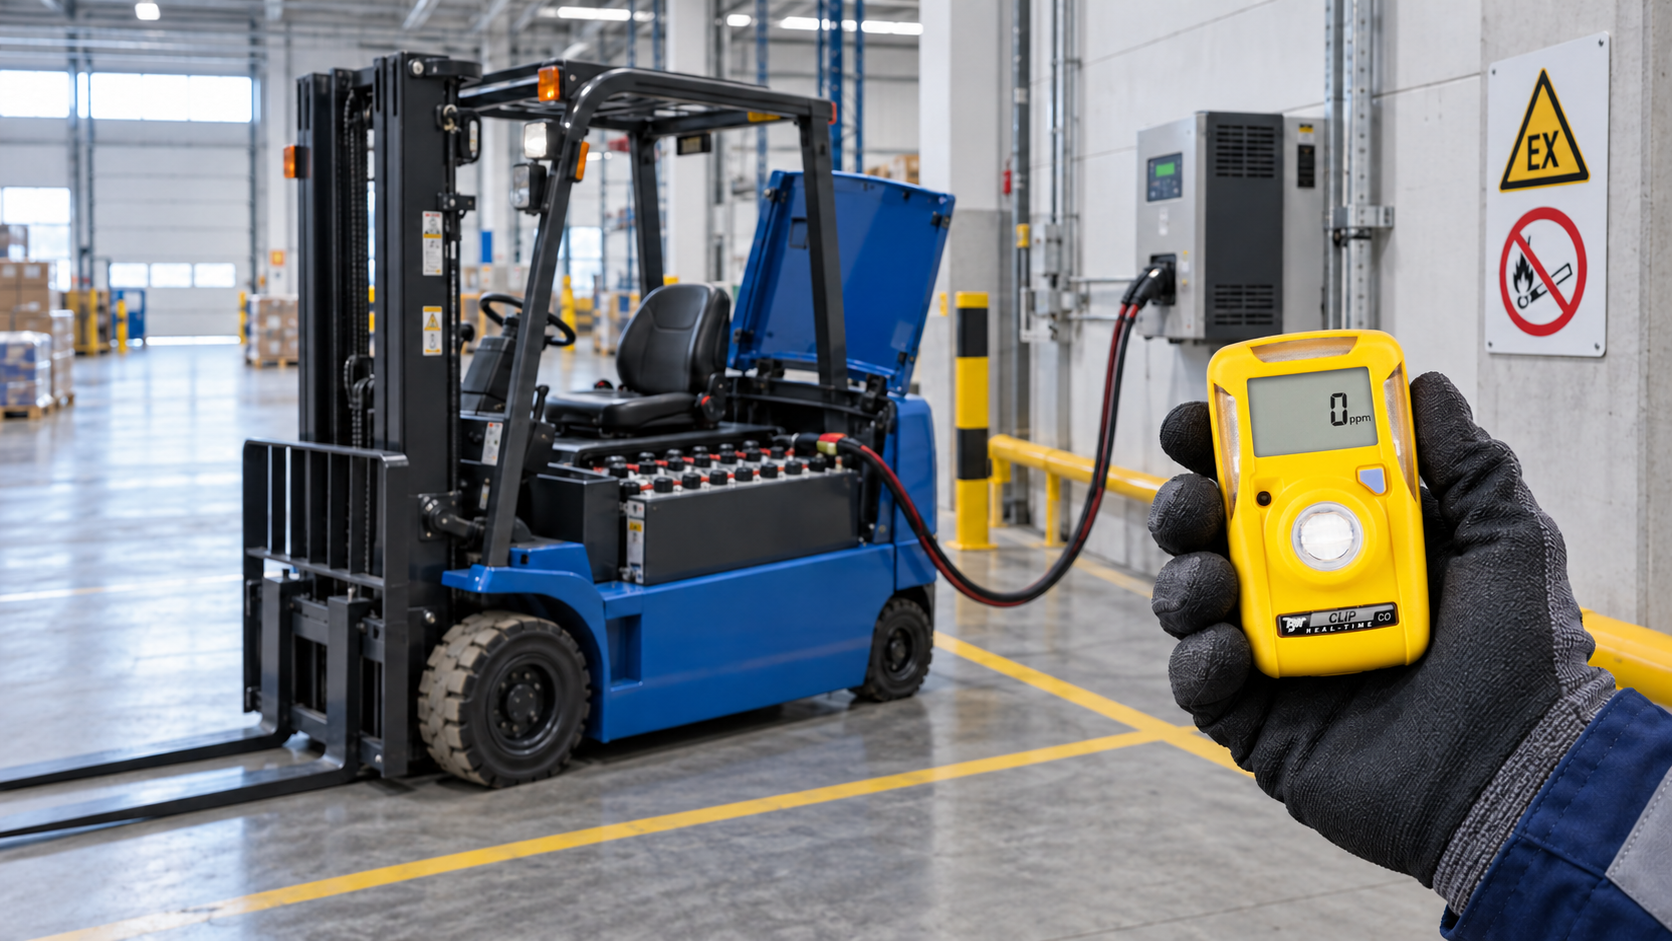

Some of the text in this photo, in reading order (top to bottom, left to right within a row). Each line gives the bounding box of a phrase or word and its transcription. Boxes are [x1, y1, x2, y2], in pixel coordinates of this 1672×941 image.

[1527, 130, 1559, 171] EX
[1330, 392, 1372, 426] 0 ppm
[1329, 611, 1356, 623] CLIP
[1377, 612, 1391, 622] CO
